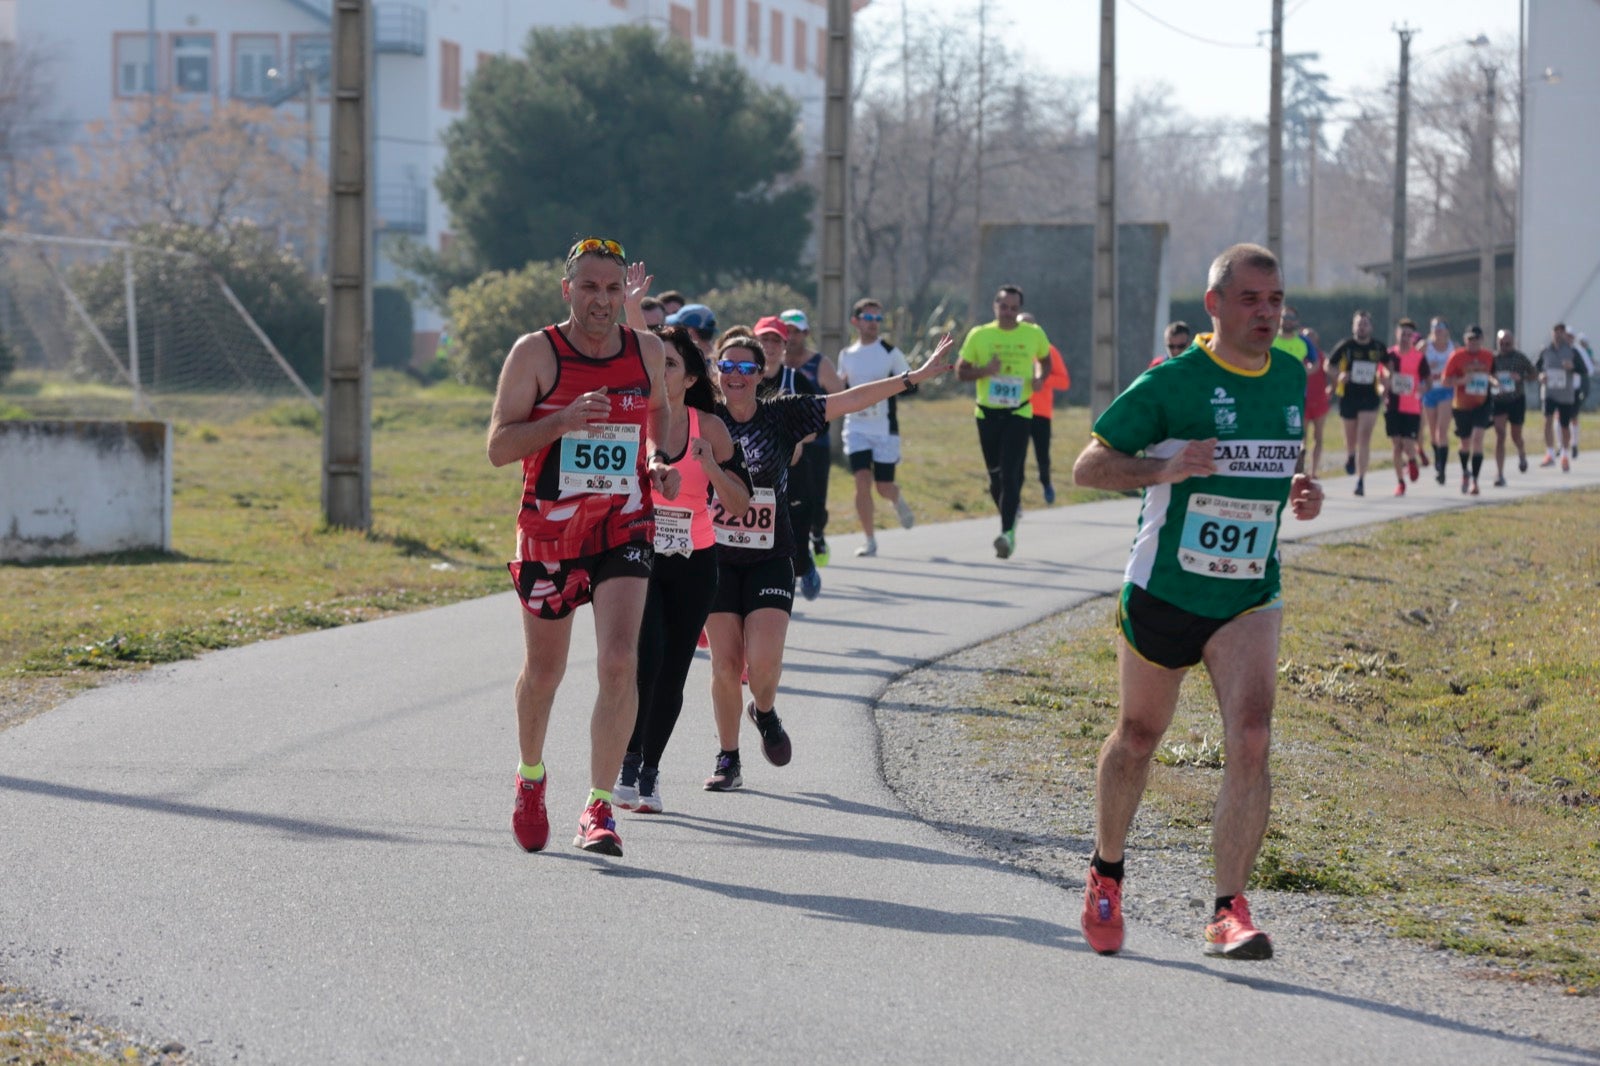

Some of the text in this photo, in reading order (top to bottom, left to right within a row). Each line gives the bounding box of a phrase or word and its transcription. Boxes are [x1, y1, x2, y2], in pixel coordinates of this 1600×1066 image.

[994, 384, 1017, 397] 991
[574, 443, 627, 471] 569
[1256, 445, 1300, 460] RURA
[1229, 461, 1284, 473] GRANADA
[660, 526, 689, 535] CONTRA
[1199, 521, 1259, 554] 691
